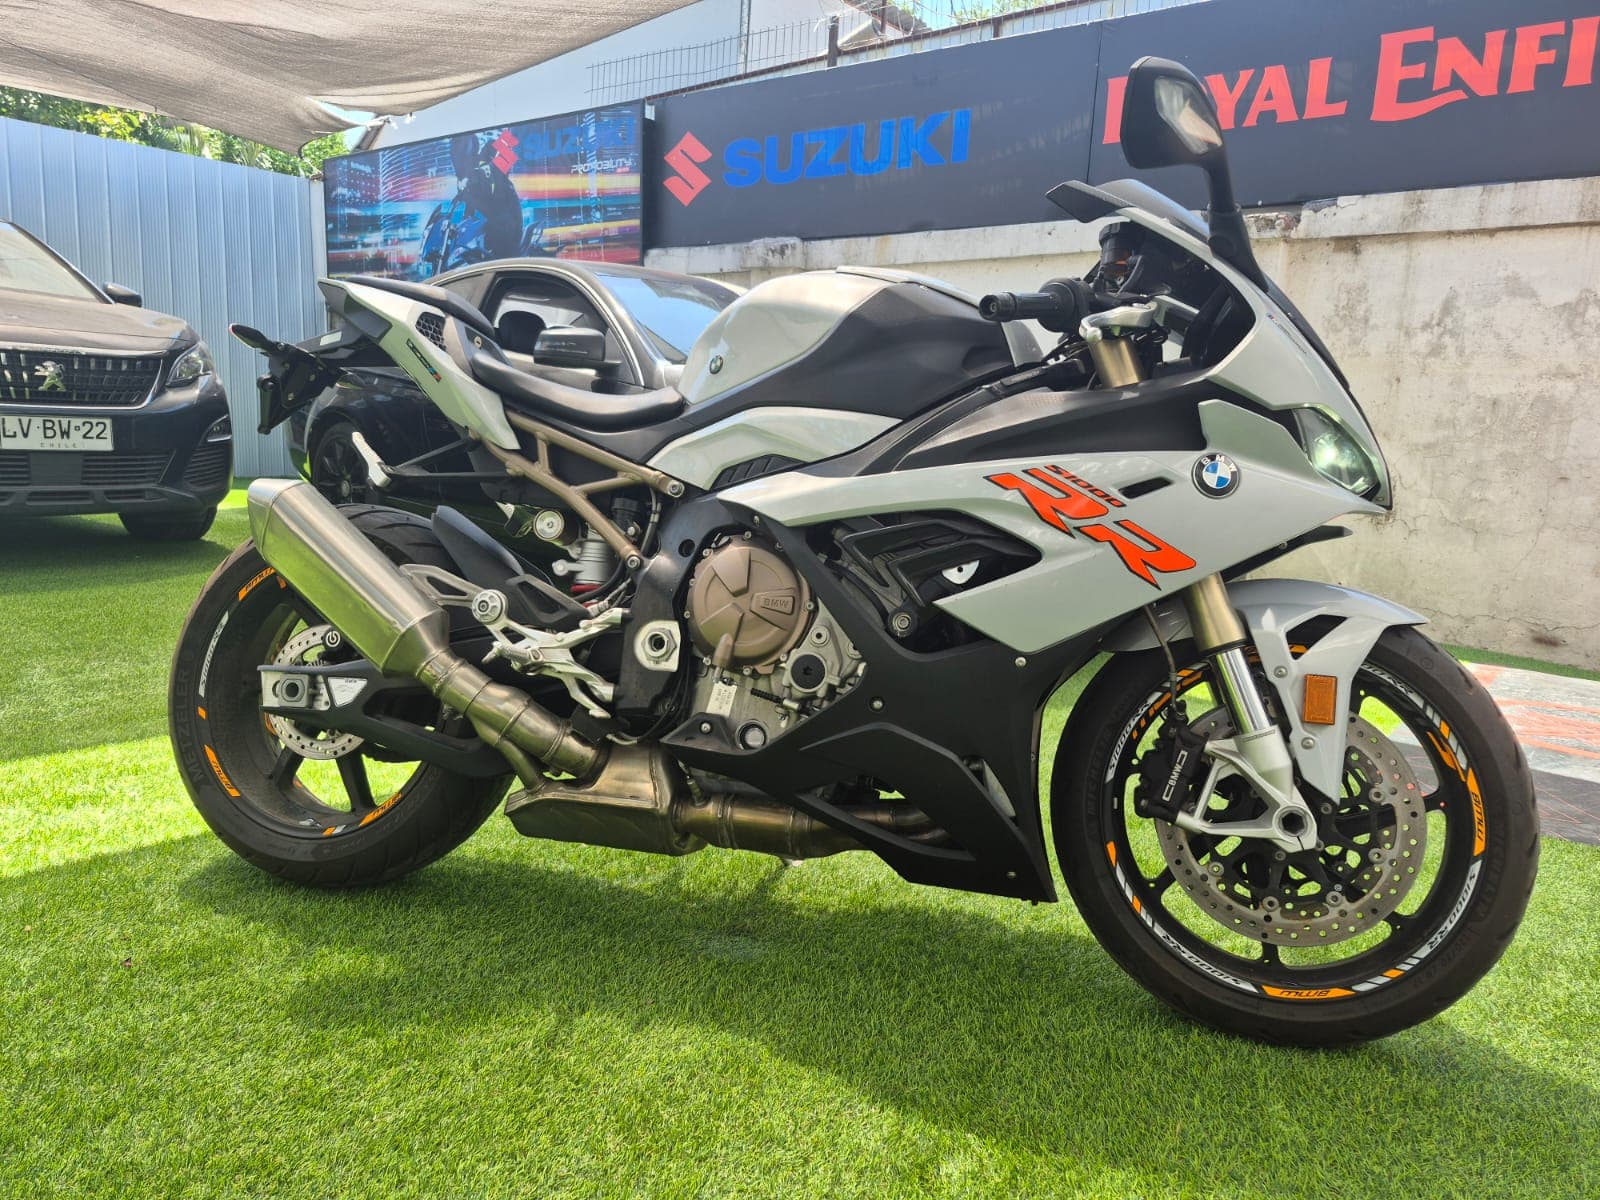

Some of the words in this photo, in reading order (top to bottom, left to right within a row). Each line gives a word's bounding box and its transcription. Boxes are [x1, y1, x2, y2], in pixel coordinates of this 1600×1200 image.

[1103, 57, 1348, 144] YAL
[523, 116, 635, 161] SUZUKI
[722, 108, 972, 188] SUZUKI
[1043, 464, 1127, 508] S1000
[983, 467, 1196, 591] RR
[763, 598, 790, 609] BMW
[1167, 764, 1183, 786] BMW
